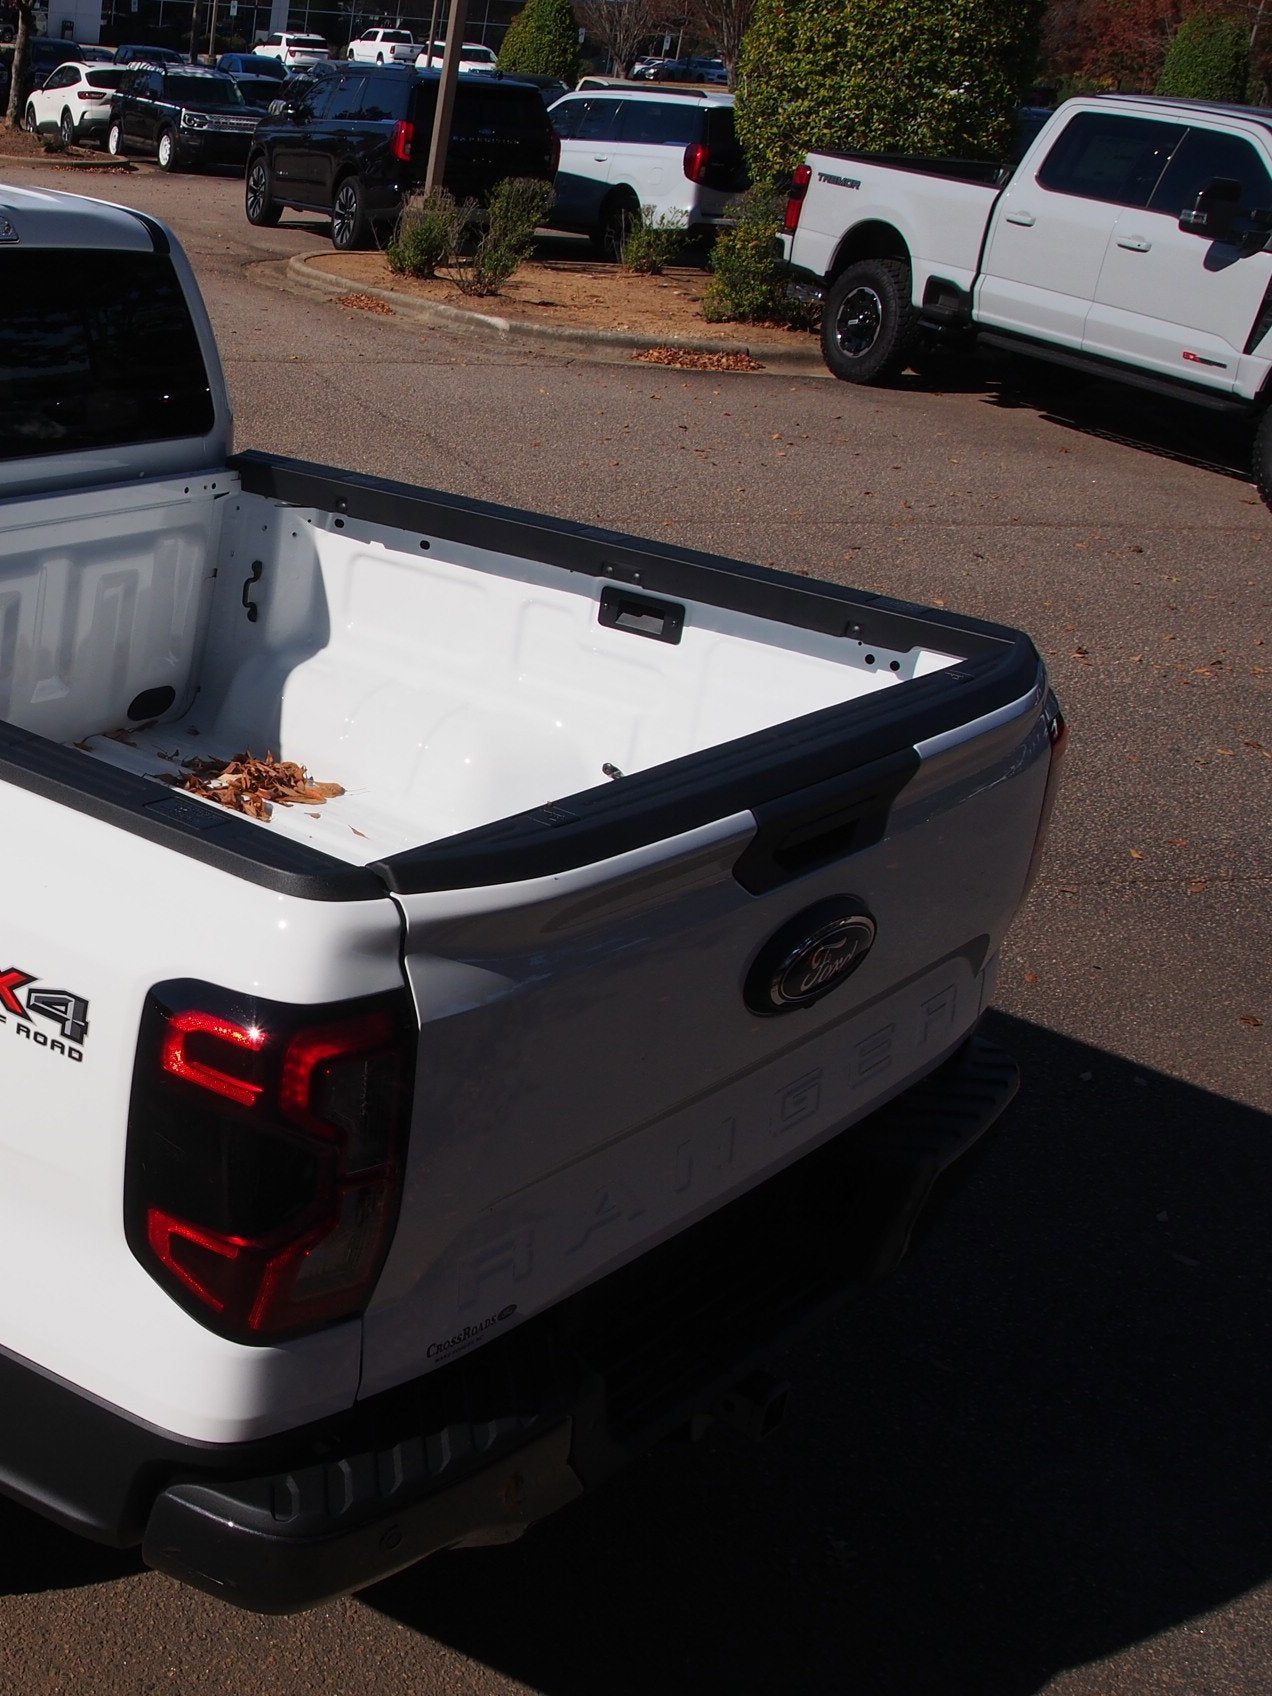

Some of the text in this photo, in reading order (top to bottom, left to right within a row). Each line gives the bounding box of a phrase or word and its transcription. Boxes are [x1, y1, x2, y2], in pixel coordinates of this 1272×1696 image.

[817, 171, 862, 191] TREMOR
[800, 936, 859, 992] Ford
[15, 1022, 84, 1063] ROAD
[457, 983, 958, 1313] RANGER
